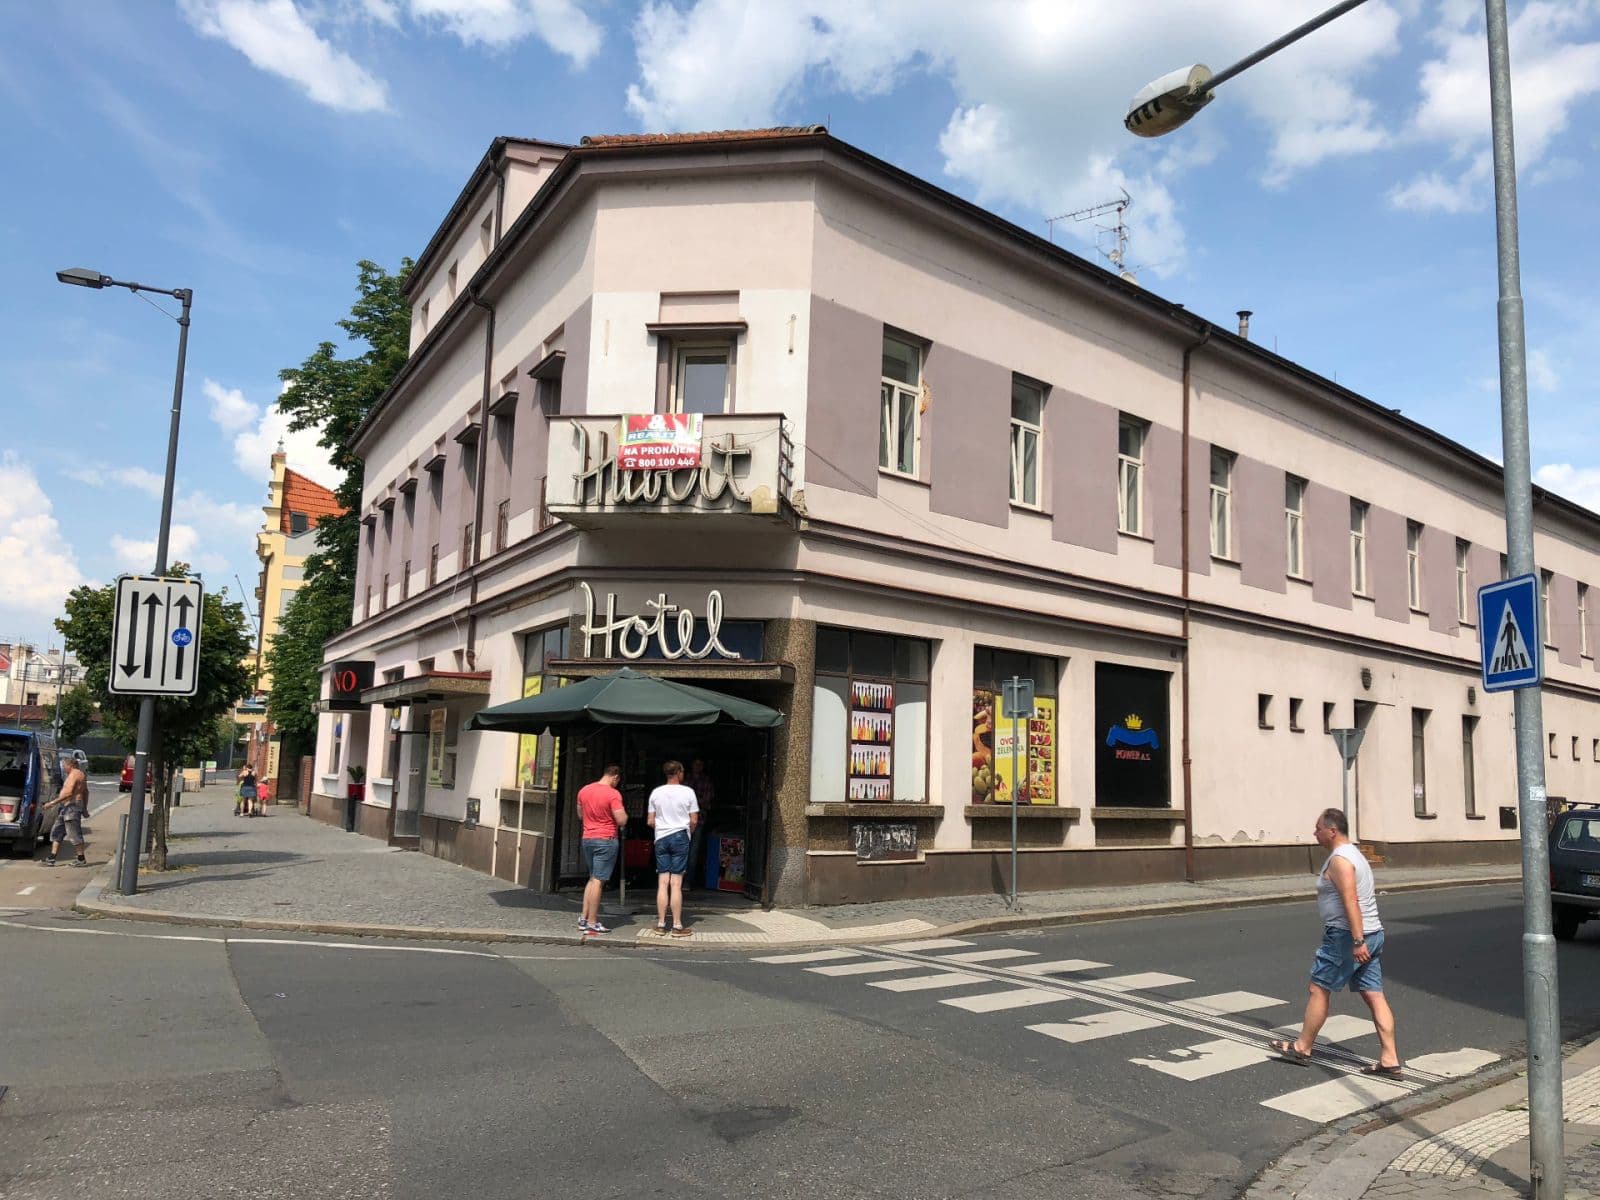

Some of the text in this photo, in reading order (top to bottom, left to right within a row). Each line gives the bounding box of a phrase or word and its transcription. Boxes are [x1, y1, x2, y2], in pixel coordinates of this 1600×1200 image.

[623, 447, 639, 456] NA
[638, 456, 695, 468] 800 100 446
[580, 580, 741, 660] Hotel
